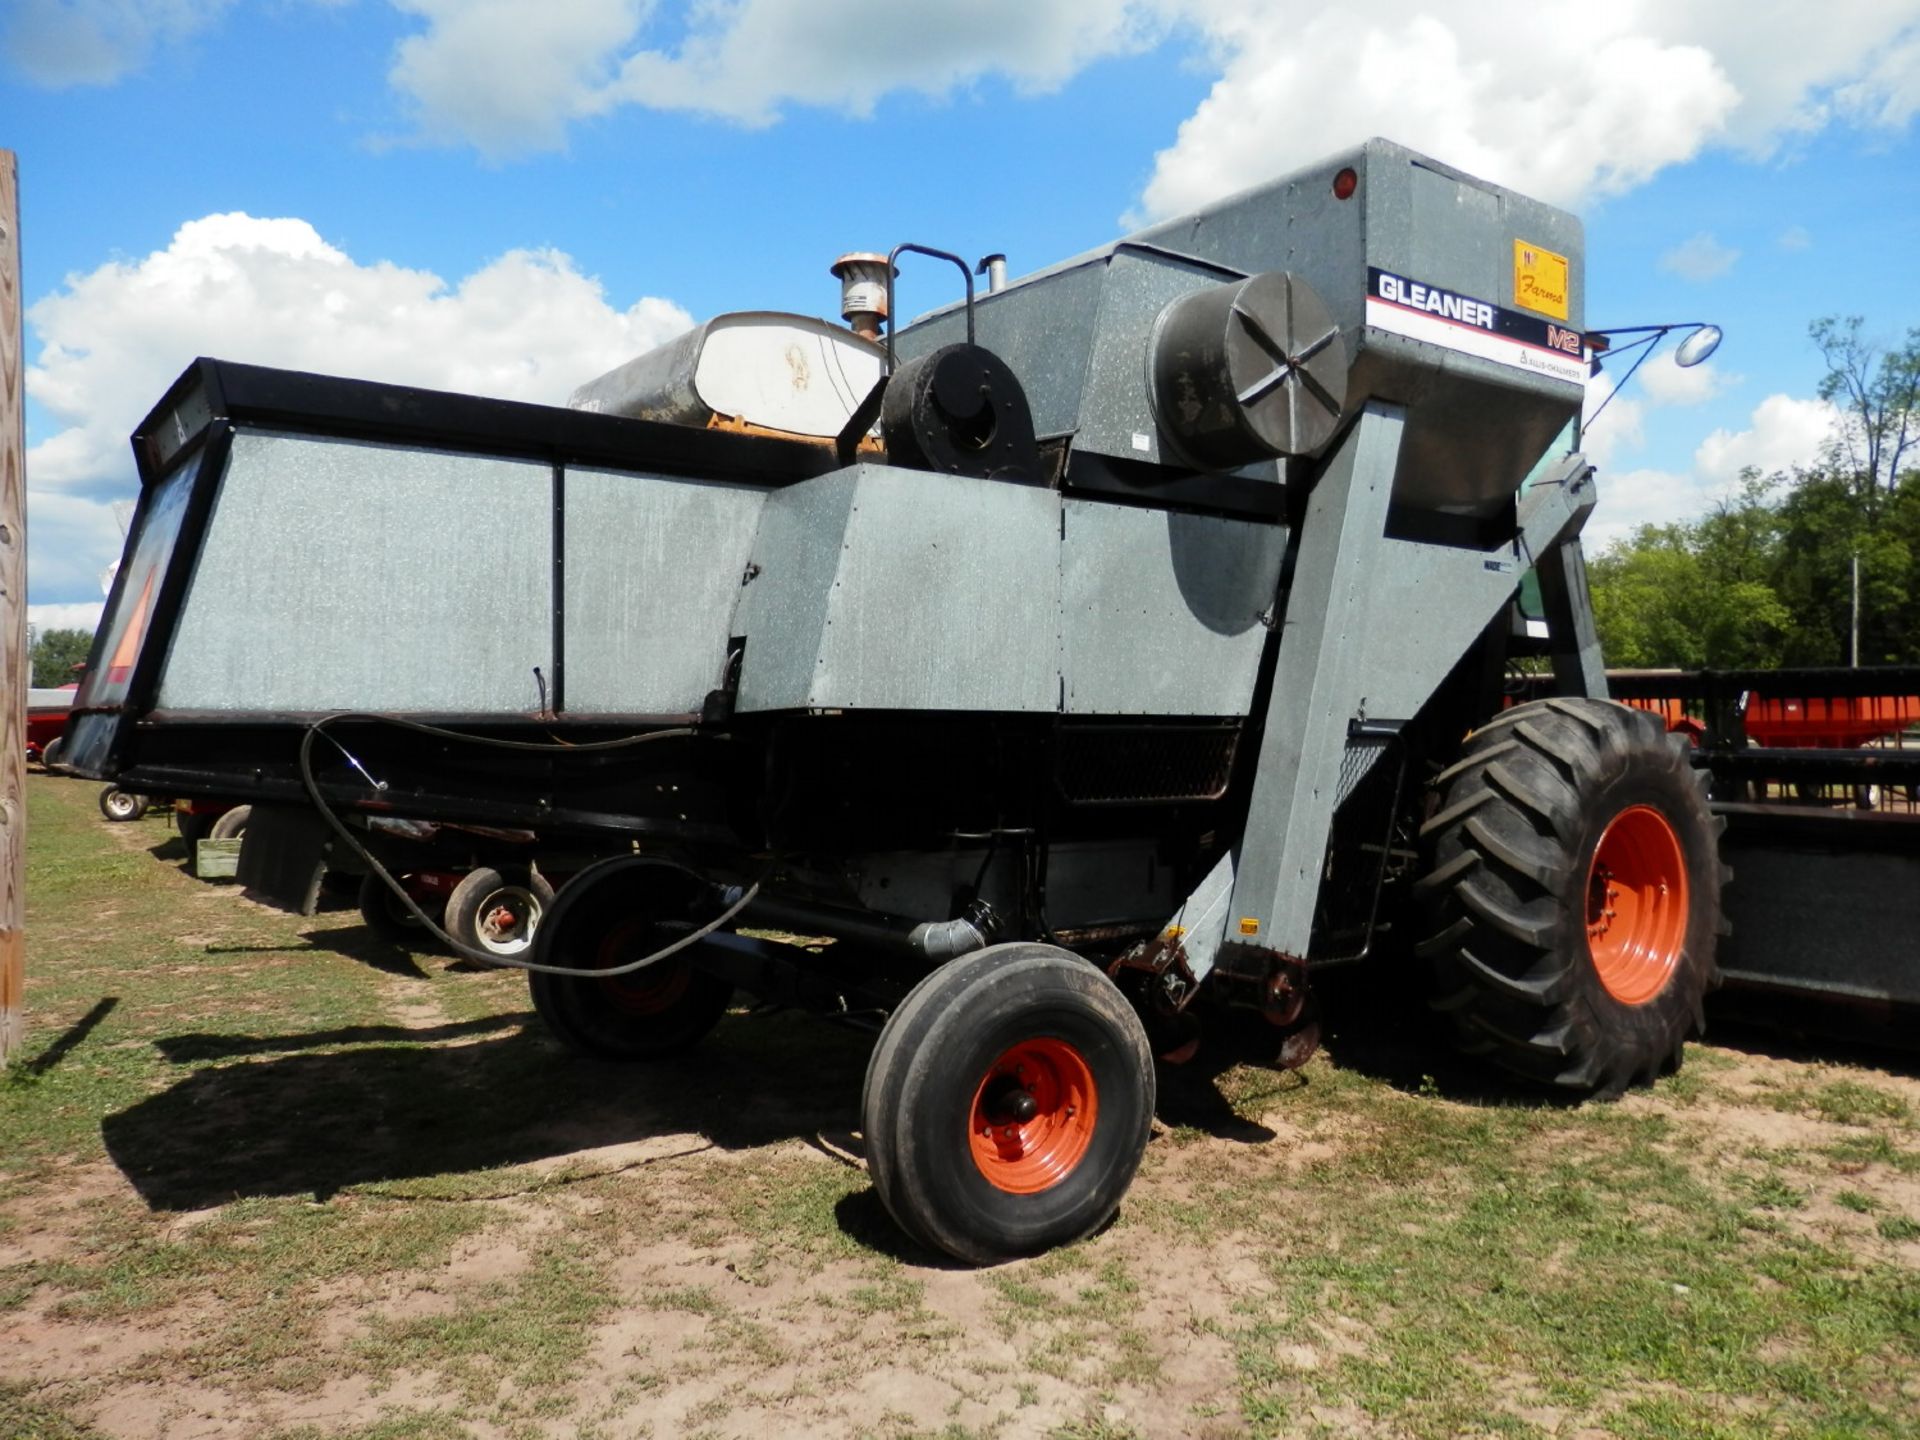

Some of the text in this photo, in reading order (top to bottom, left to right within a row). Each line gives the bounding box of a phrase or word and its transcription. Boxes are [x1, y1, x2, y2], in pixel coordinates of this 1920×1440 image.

[1379, 274, 1493, 329] GLEANER
[1522, 275, 1563, 304] Farms
[1547, 324, 1579, 354] M2
